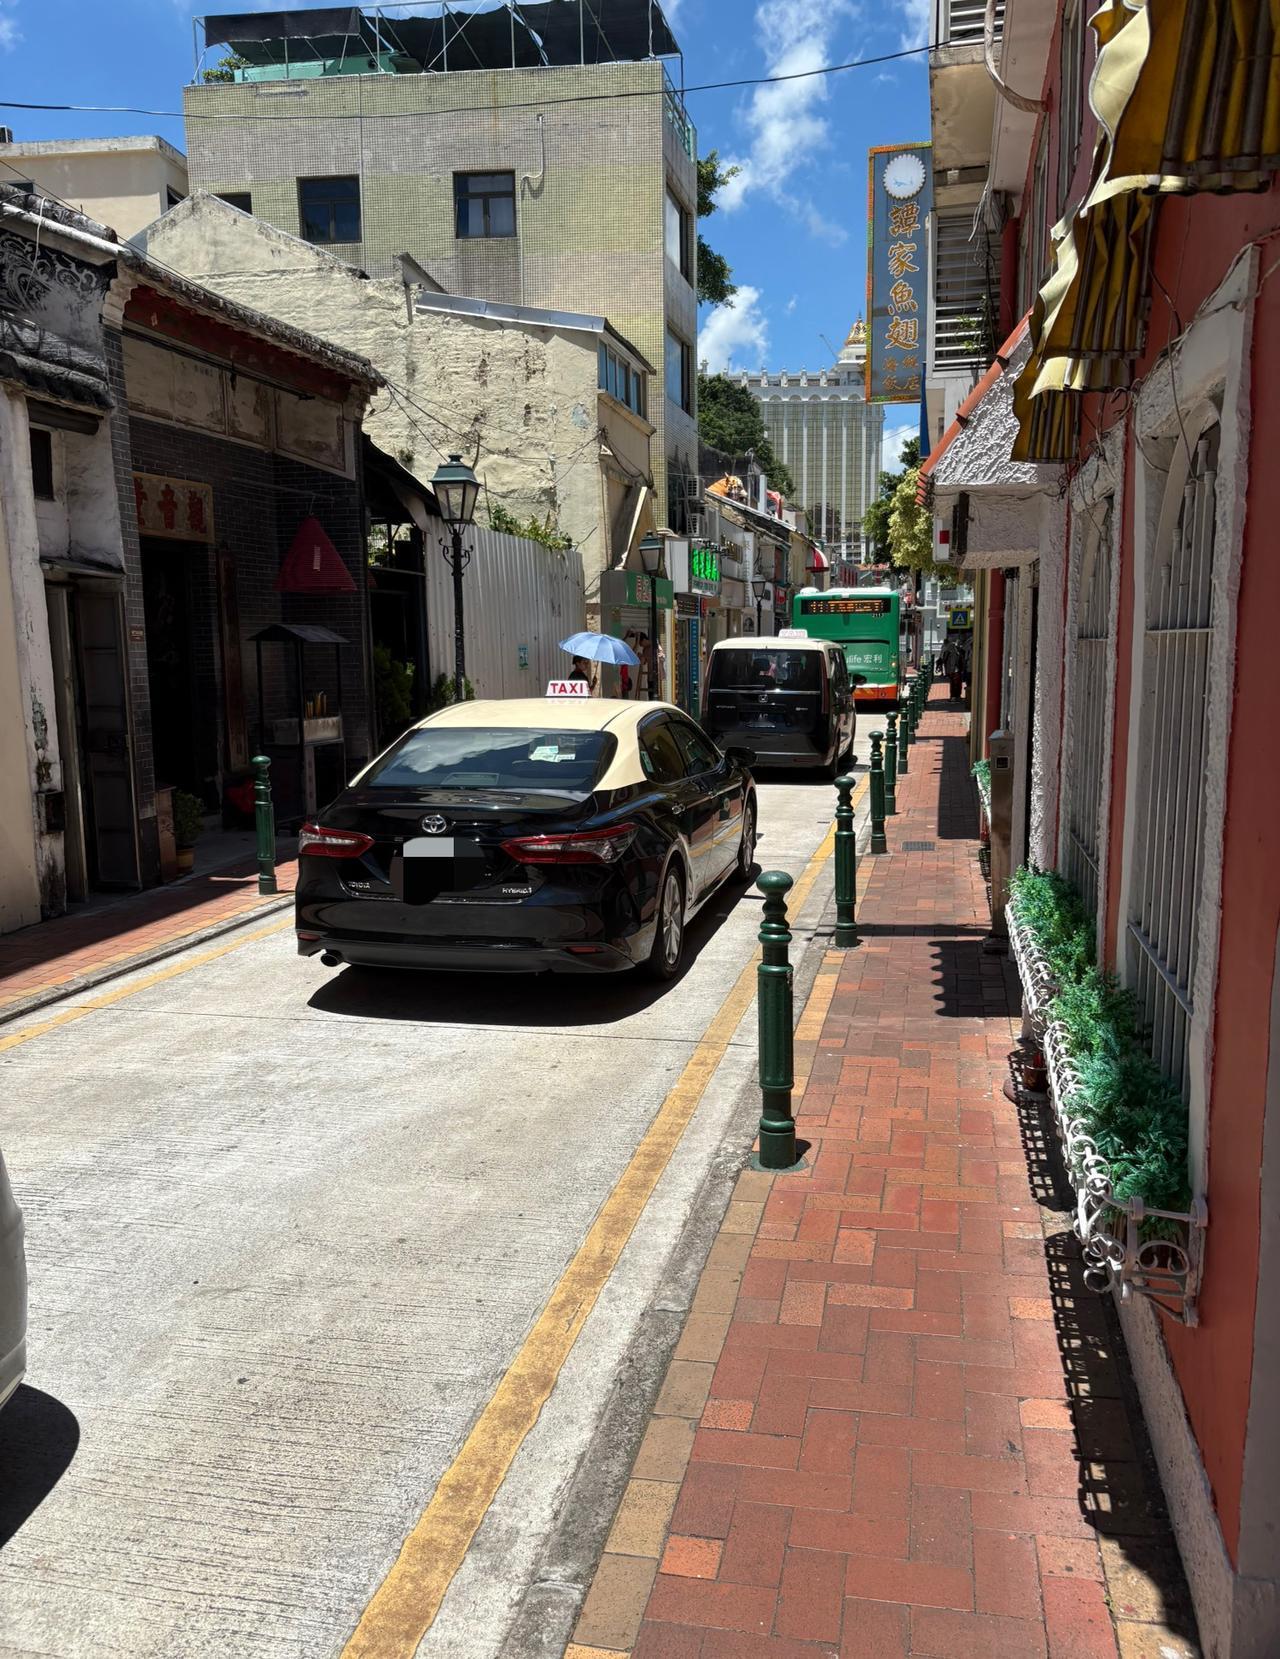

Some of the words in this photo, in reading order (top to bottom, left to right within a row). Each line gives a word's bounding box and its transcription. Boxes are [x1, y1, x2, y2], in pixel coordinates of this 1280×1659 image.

[885, 201, 921, 350] 譚家魚翅
[550, 683, 583, 694] TAXI
